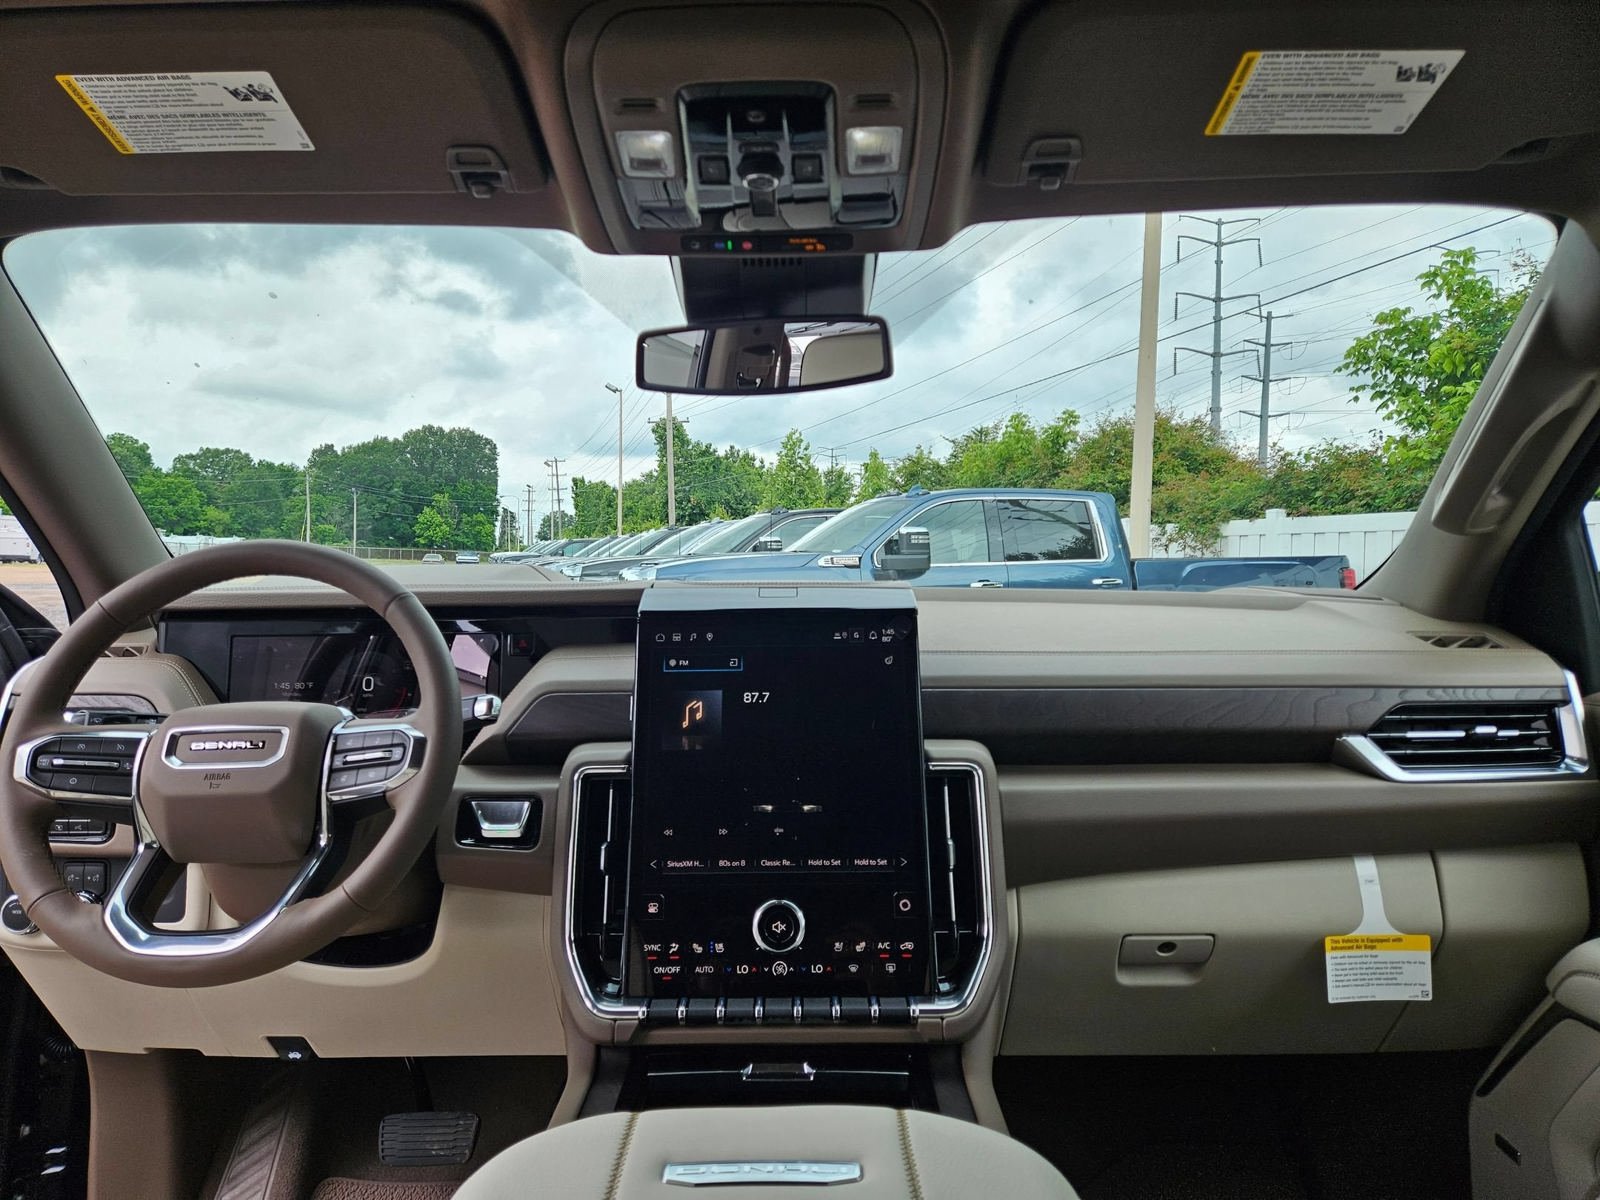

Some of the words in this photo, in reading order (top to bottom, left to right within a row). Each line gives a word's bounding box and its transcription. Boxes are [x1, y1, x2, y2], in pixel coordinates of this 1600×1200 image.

[362, 676, 375, 692] 0
[743, 692, 770, 703] 87.7
[190, 741, 266, 751] DENALI
[203, 772, 232, 781] AIRBAG
[667, 860, 693, 868] SiriusXM
[760, 859, 781, 867] Classic
[831, 858, 841, 866] Set
[854, 858, 869, 866] Hold
[877, 858, 888, 866] Set
[1366, 937, 1391, 945] Equipped
[643, 944, 661, 952] SYNC
[878, 941, 891, 950] A/C
[653, 966, 681, 974] ON/OFF
[695, 966, 714, 974] AUTO
[736, 964, 749, 974] LO
[811, 963, 824, 974] LO
